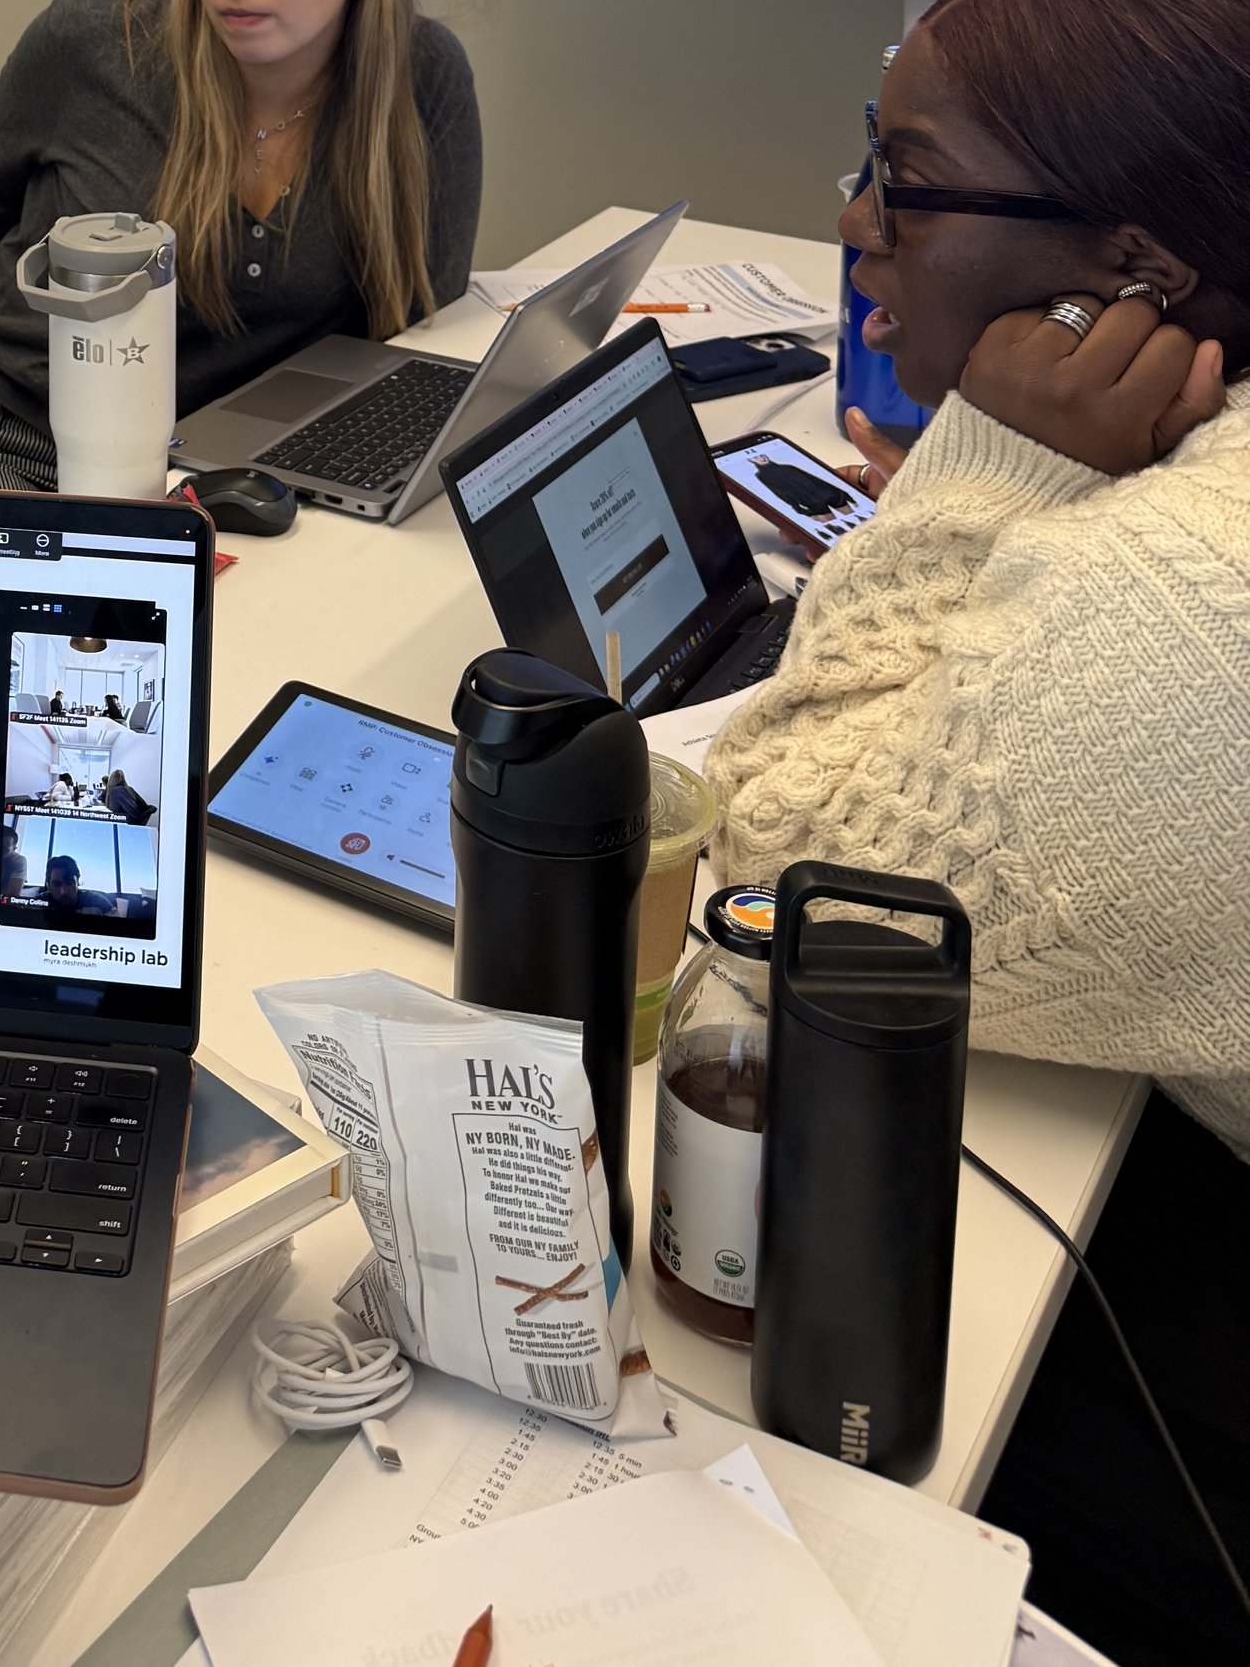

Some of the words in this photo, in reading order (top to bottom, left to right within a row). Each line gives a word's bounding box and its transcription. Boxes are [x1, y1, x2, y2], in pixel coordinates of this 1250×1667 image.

[358, 719, 378, 732] RMP:
[378, 726, 416, 745] Customer
[417, 739, 454, 757] Obsessio
[44, 940, 135, 965] leadership
[141, 950, 168, 966] lab
[62, 960, 97, 968] deshmukh
[300, 1050, 349, 1078] Nutrition
[471, 1101, 512, 1110] NEW
[110, 1116, 138, 1125] delete
[509, 1123, 521, 1132] Hal
[523, 1126, 536, 1134] was
[334, 1117, 352, 1138] 110
[356, 1130, 377, 1150] 220
[466, 1133, 482, 1144] NY
[486, 1132, 522, 1149] BORN,
[526, 1136, 540, 1150] NY
[544, 1142, 575, 1160] MADE.
[503, 1148, 518, 1159] also
[526, 1152, 542, 1163] little
[489, 1158, 498, 1166] He
[500, 1159, 511, 1168] did
[513, 1162, 535, 1174] things
[537, 1166, 547, 1176] his
[98, 1183, 127, 1192] return
[482, 1168, 491, 1177] To
[493, 1170, 513, 1180] honor
[515, 1175, 527, 1183] Hal
[541, 1180, 558, 1191] make
[559, 1186, 571, 1194] our
[490, 1181, 512, 1192] Baked
[514, 1186, 544, 1198] Pretzels
[551, 1194, 566, 1204] little
[485, 1193, 522, 1208] differently
[546, 1203, 557, 1213] Our
[99, 1220, 121, 1228] shift
[494, 1206, 526, 1219] Different
[536, 1213, 568, 1226] beautiful
[499, 1220, 512, 1229] and
[514, 1222, 519, 1230] it
[490, 1234, 514, 1244] FROM
[515, 1238, 532, 1248] OUR
[534, 1241, 546, 1251] NY
[548, 1241, 578, 1252] FAMILY
[496, 1244, 507, 1252] TO
[547, 1252, 577, 1262] ENJOY!
[516, 1318, 561, 1329] Guaranteed
[563, 1320, 583, 1329] fresh
[505, 1328, 535, 1338] through
[510, 1338, 523, 1346] Any
[526, 1341, 564, 1349] questions
[840, 1401, 870, 1464] MiiR
